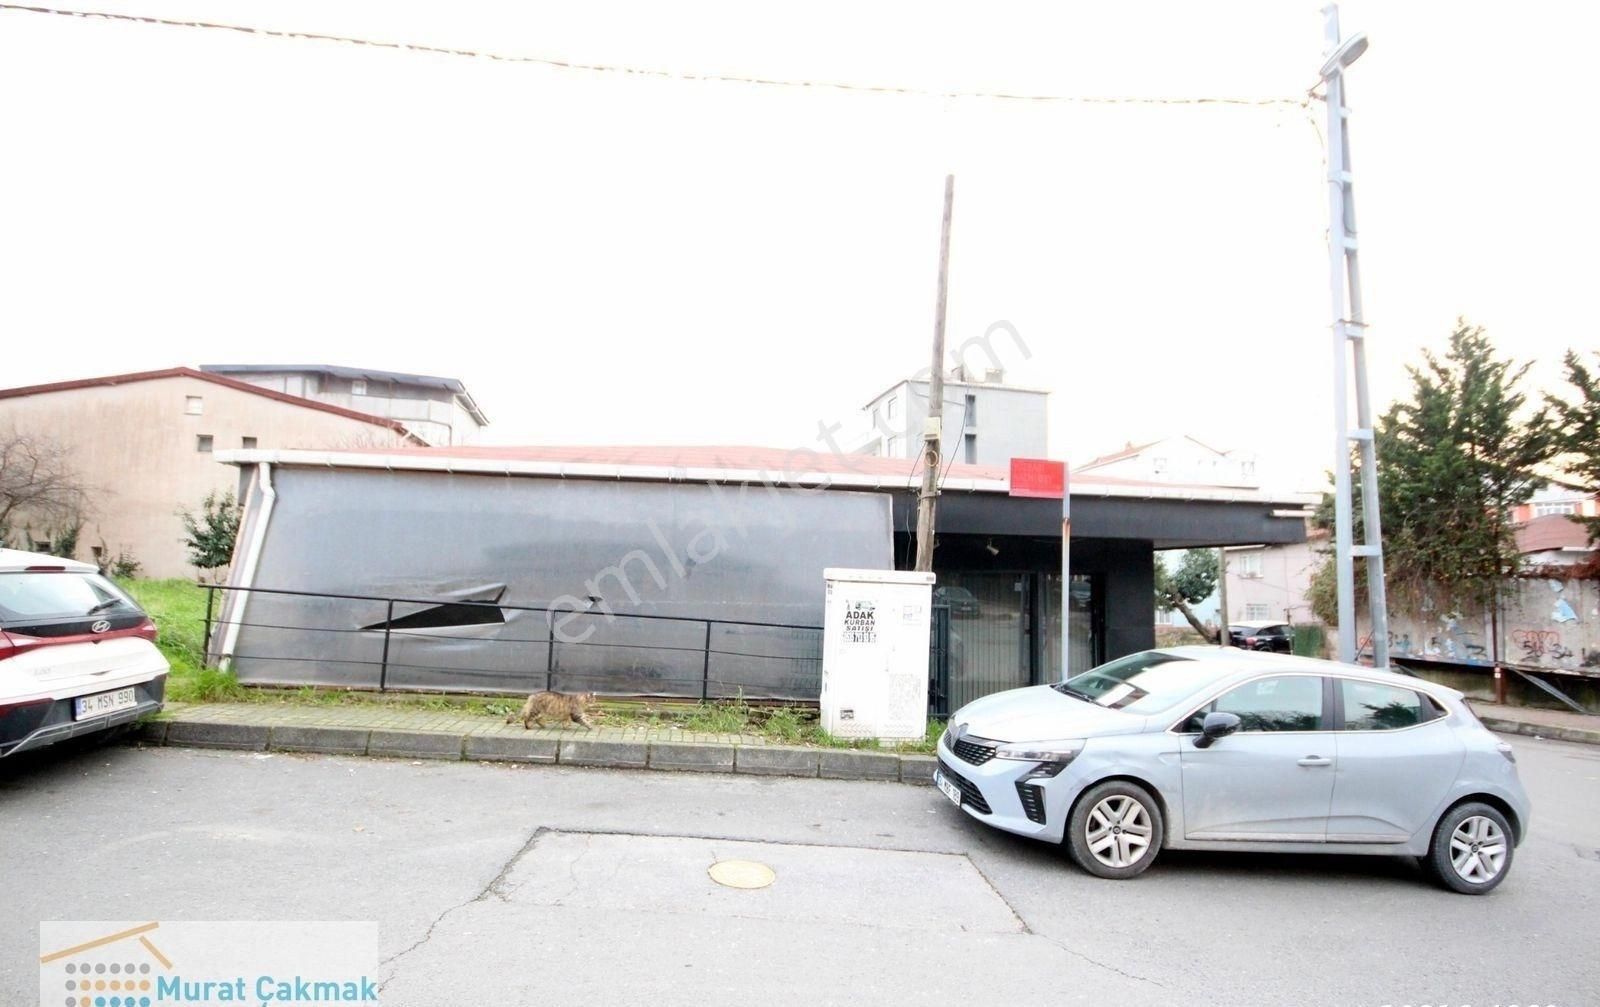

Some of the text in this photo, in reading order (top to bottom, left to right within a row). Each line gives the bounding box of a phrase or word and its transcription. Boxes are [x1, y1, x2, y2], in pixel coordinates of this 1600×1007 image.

[846, 611, 873, 619] ADAK
[81, 689, 134, 713] 34 MSN 990
